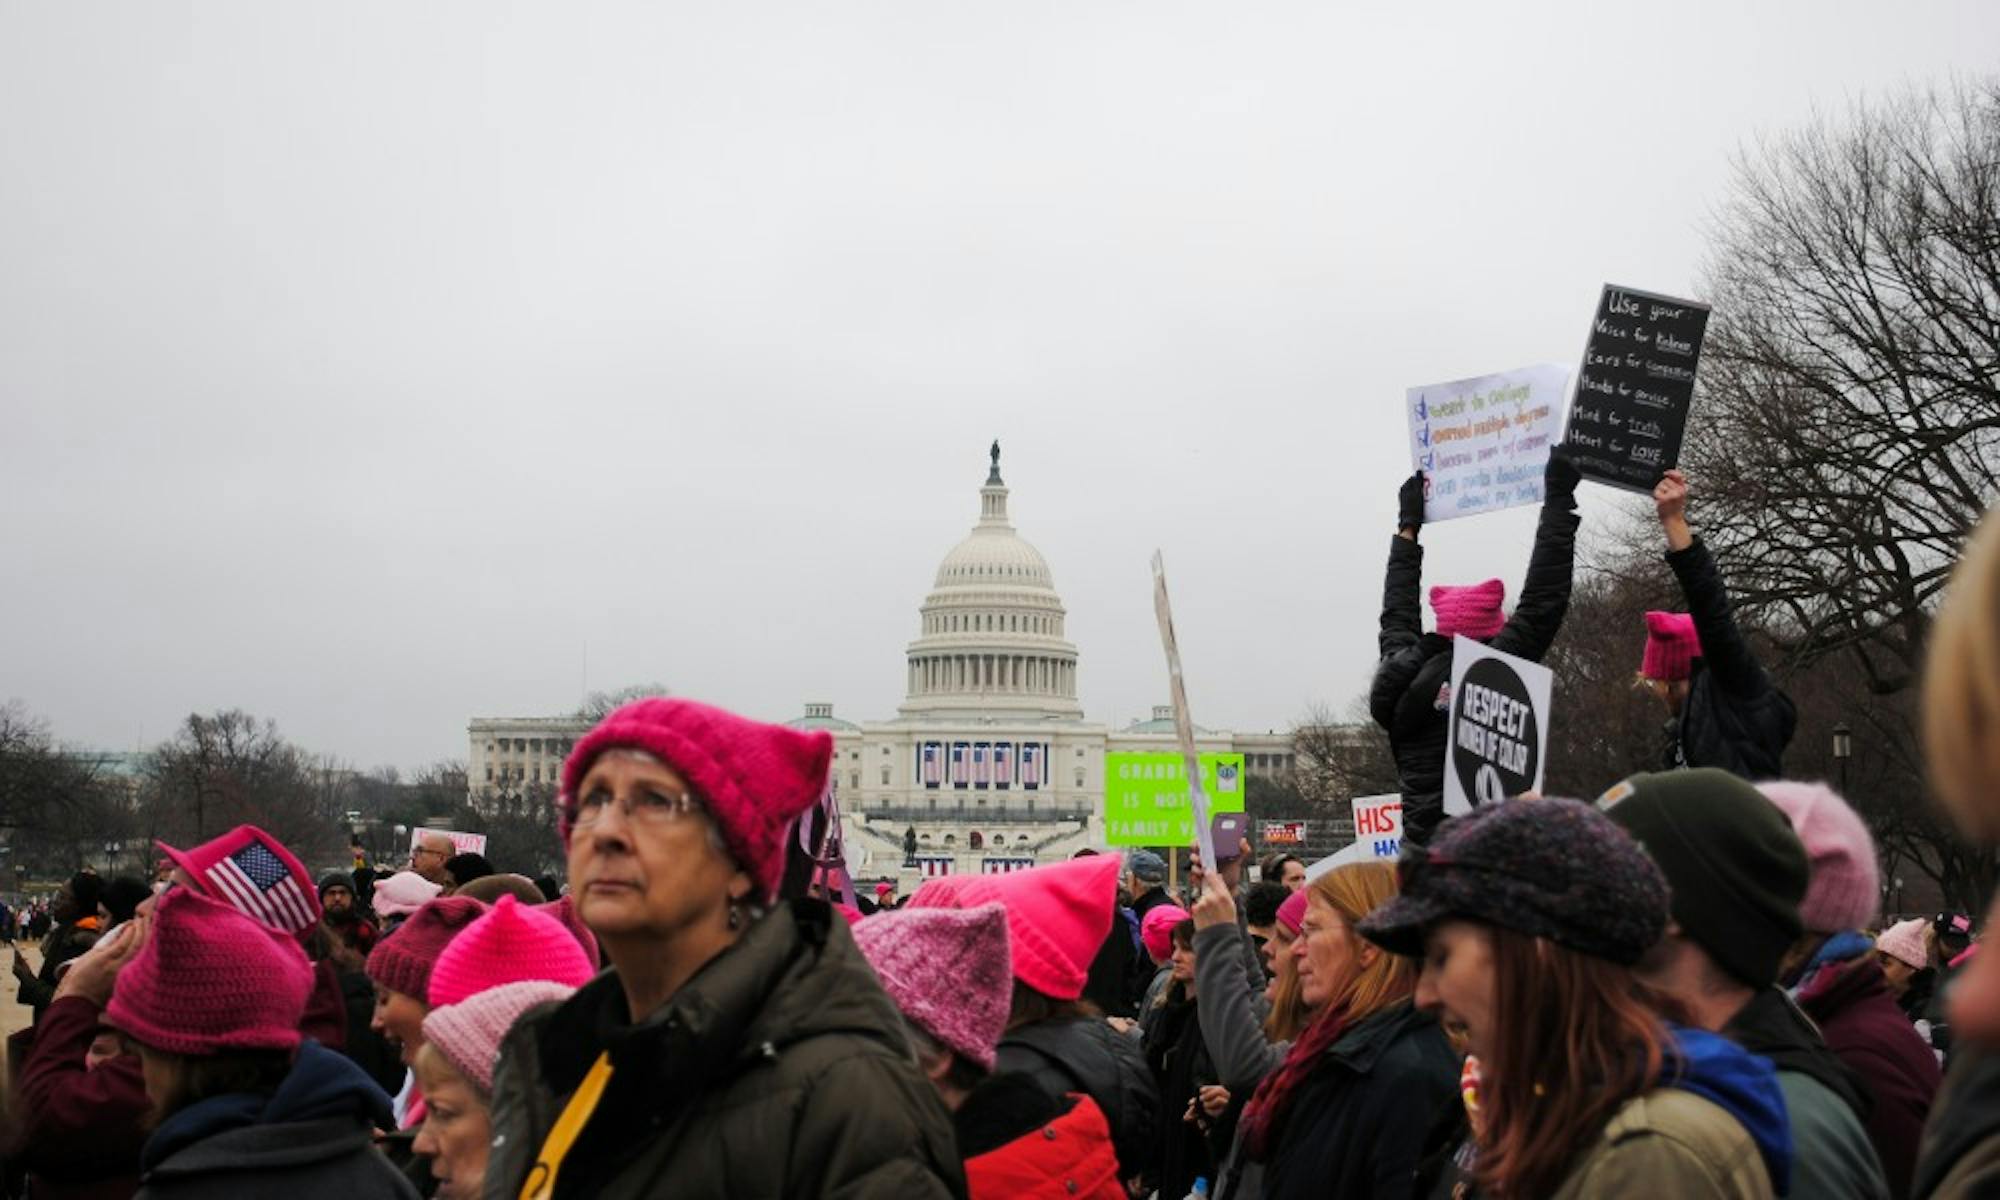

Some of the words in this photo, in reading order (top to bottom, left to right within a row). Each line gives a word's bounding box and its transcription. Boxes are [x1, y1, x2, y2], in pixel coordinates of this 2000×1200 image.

[1608, 291, 1641, 318] Use
[1633, 326, 1649, 343] for
[1586, 346, 1621, 368] Ears
[1625, 352, 1641, 369] for
[1580, 374, 1614, 395] Hands
[1573, 404, 1601, 423] Mind
[1608, 410, 1622, 426] for
[1569, 428, 1602, 448] Heart
[1463, 682, 1530, 741] RESPECT
[1119, 762, 1210, 780] GRABBIG
[1122, 792, 1140, 809] IS
[1155, 793, 1185, 809] NOT
[1110, 820, 1169, 837] FAMILY
